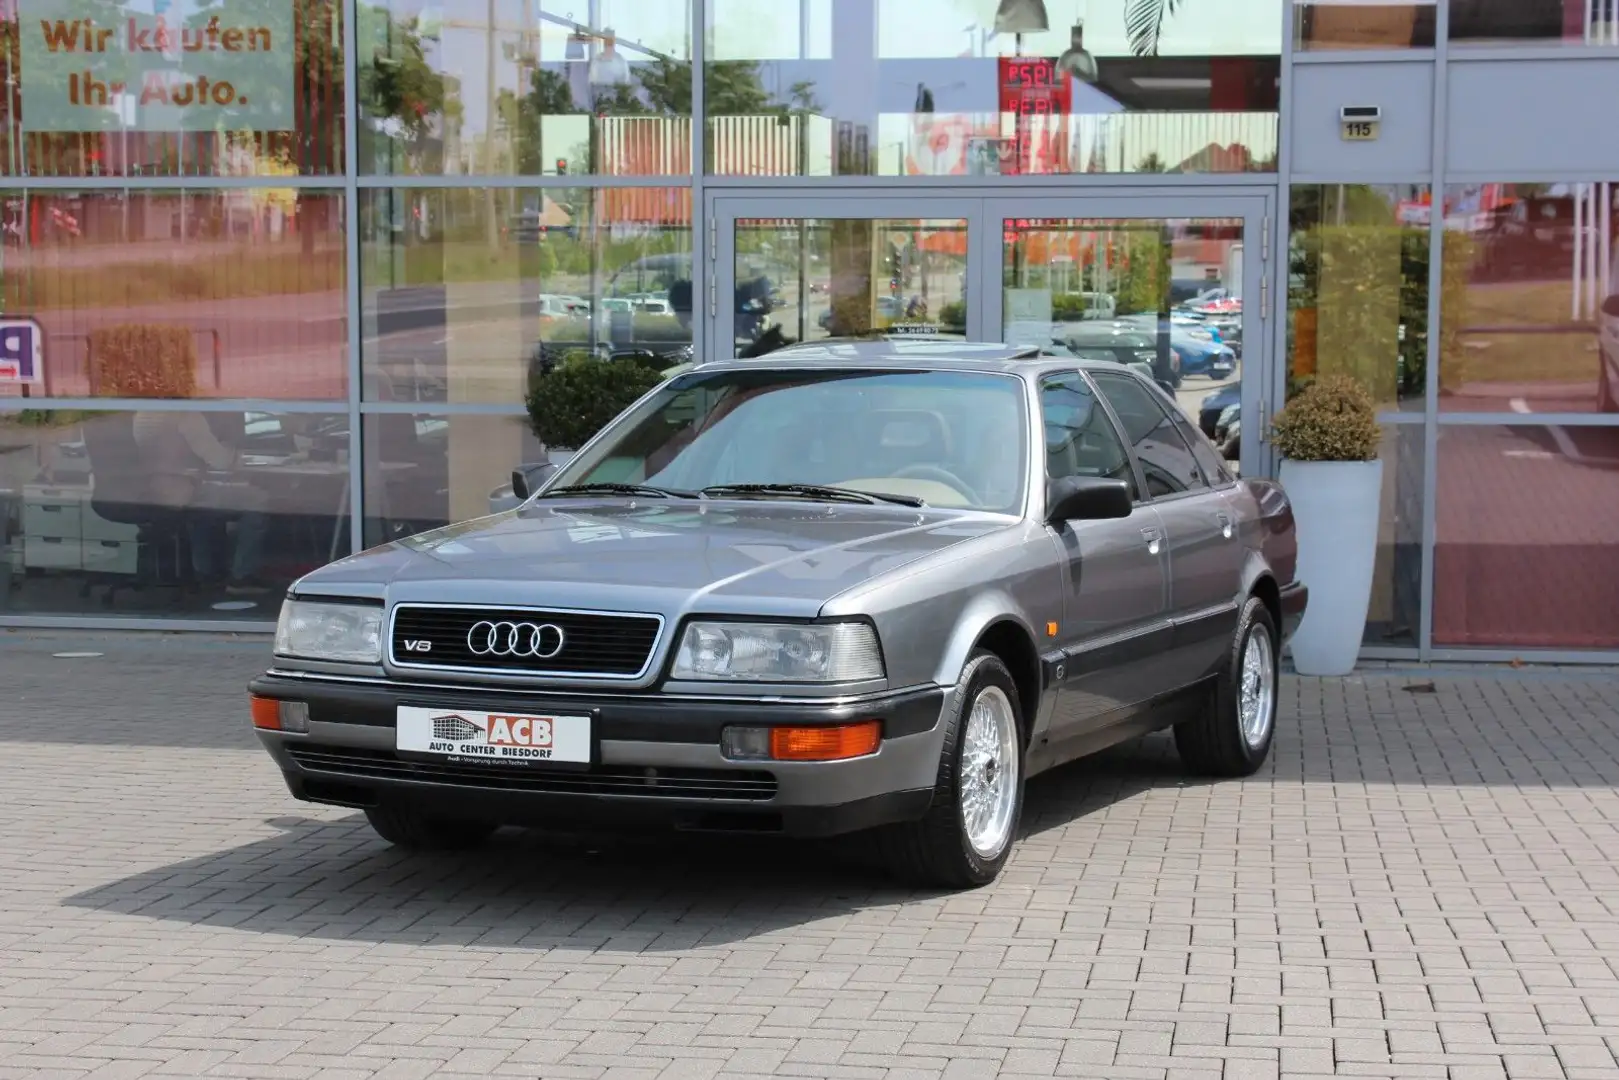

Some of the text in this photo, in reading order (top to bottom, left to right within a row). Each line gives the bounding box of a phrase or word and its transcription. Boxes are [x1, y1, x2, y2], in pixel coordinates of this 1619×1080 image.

[40, 16, 271, 52] Wir kaufen
[69, 70, 248, 106] Ihr Auto.
[1346, 122, 1371, 137] 115
[404, 639, 432, 651] V8
[489, 717, 552, 746] ACB
[429, 742, 552, 758] AUTO CENTER BIESDORF
